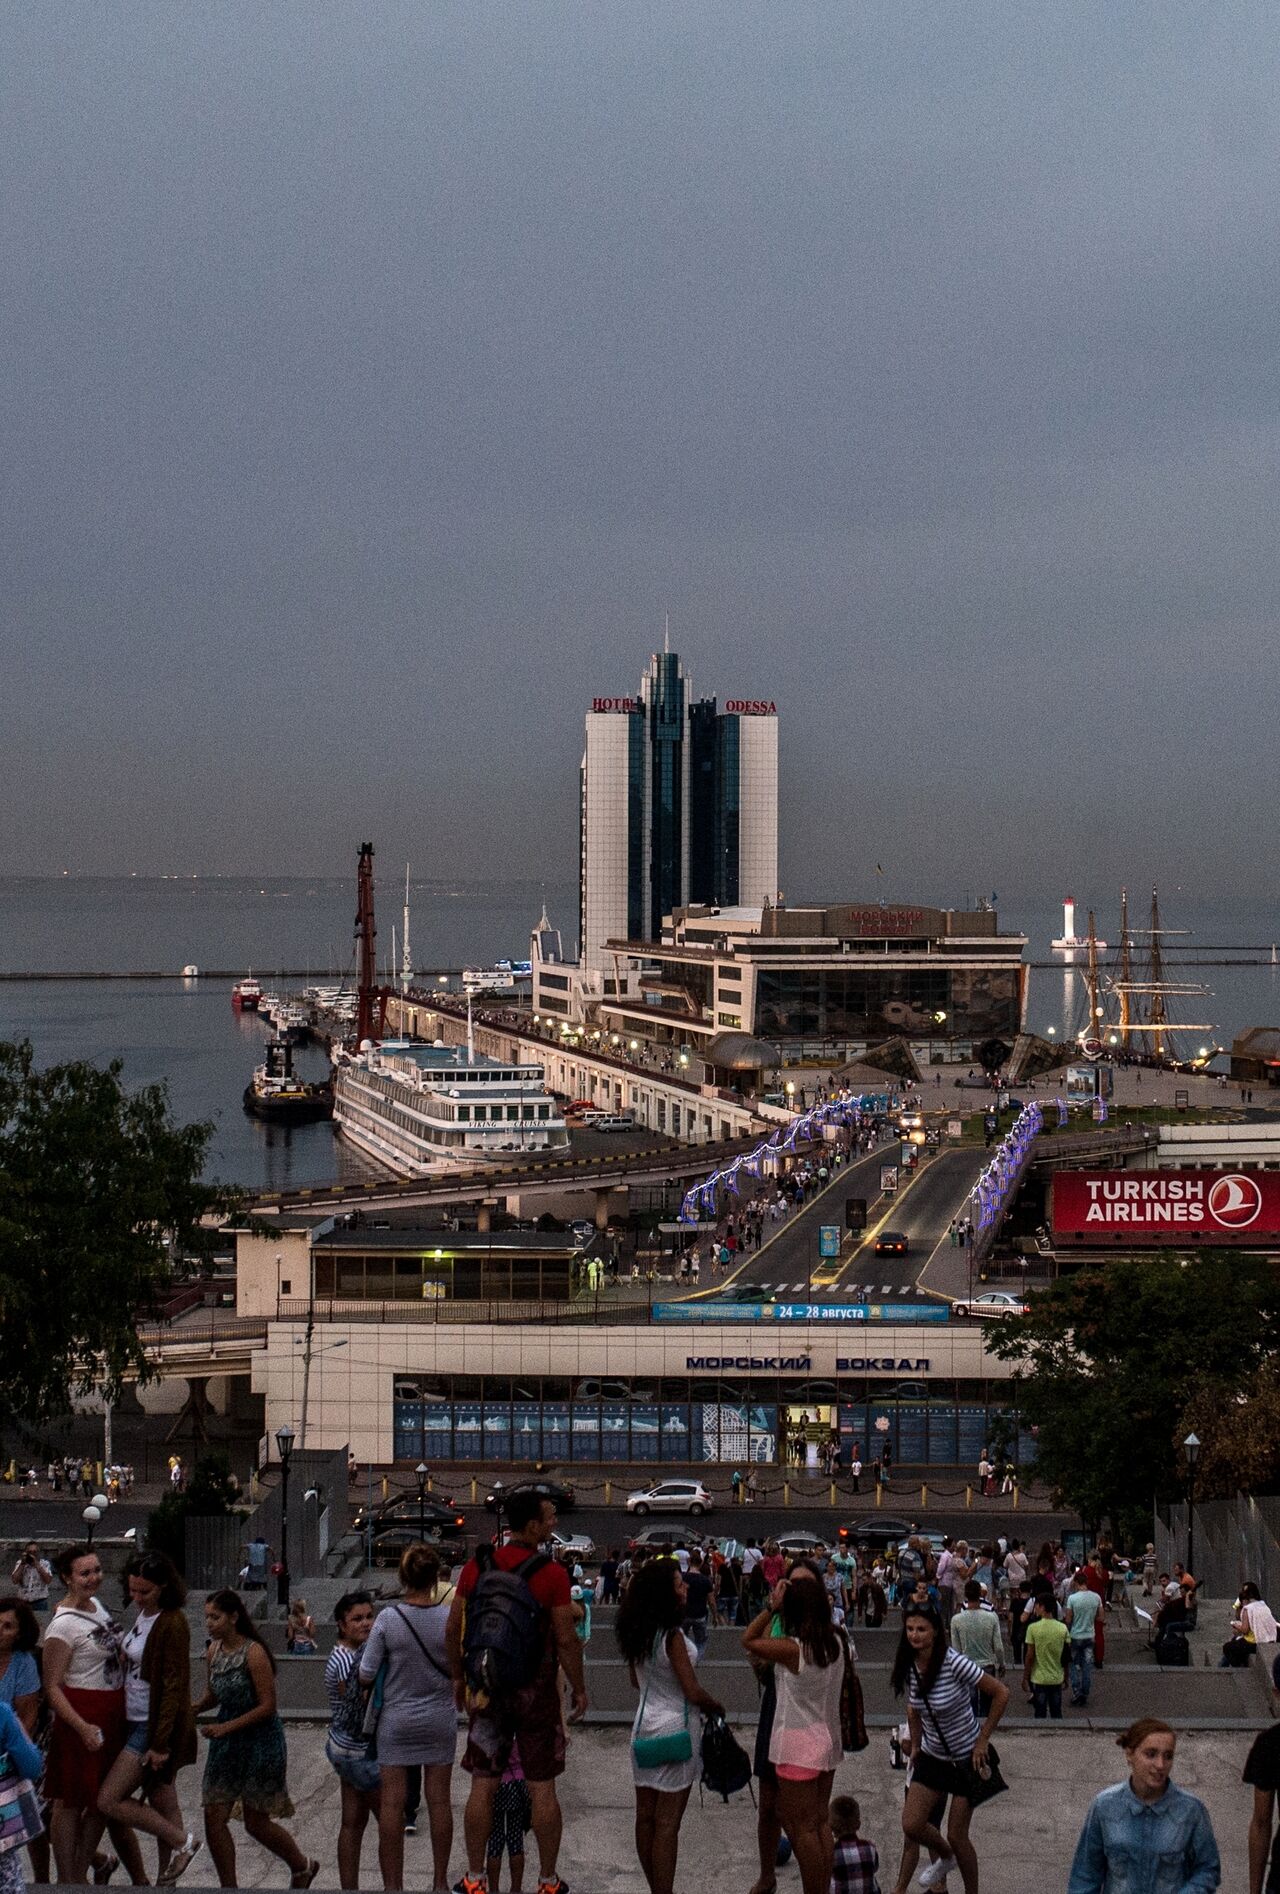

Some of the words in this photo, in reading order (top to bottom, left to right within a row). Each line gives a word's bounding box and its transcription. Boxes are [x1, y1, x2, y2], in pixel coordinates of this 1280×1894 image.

[725, 700, 776, 712] ODESSA
[468, 1120, 497, 1128] VIKING
[513, 1119, 547, 1127] CRUISES
[1086, 1181, 1203, 1199] TURKISH
[1085, 1202, 1204, 1221] AIRLINES
[779, 1306, 793, 1318] 24
[806, 1306, 820, 1318] 28
[821, 1308, 864, 1320] августа
[686, 1356, 811, 1371] МОРСЬКИЙ
[836, 1358, 930, 1371] ВОКЗАЛ
